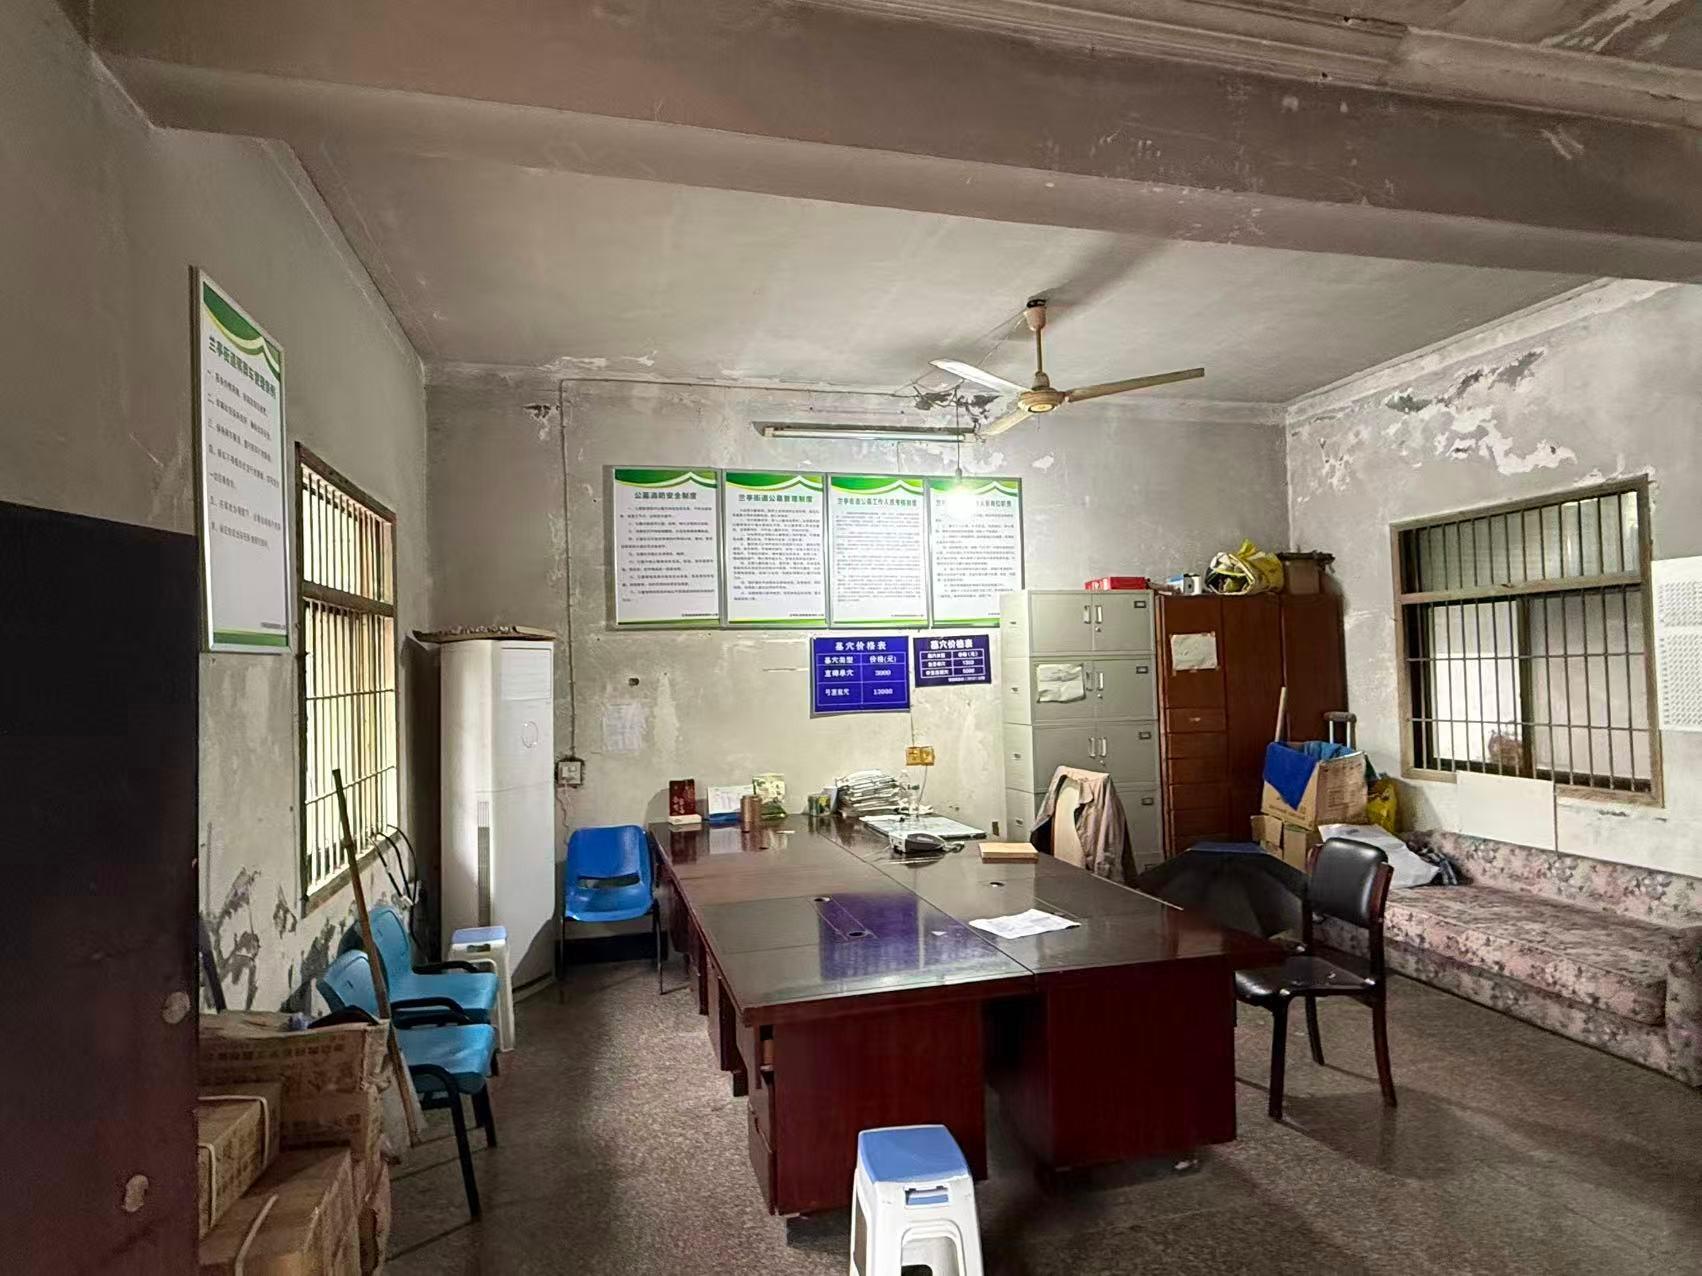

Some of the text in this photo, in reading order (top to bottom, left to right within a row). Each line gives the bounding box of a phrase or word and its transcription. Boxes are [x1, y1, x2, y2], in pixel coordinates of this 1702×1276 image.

[835, 641, 886, 651] 墓穴价格表
[930, 639, 973, 650] 墓穴价格表
